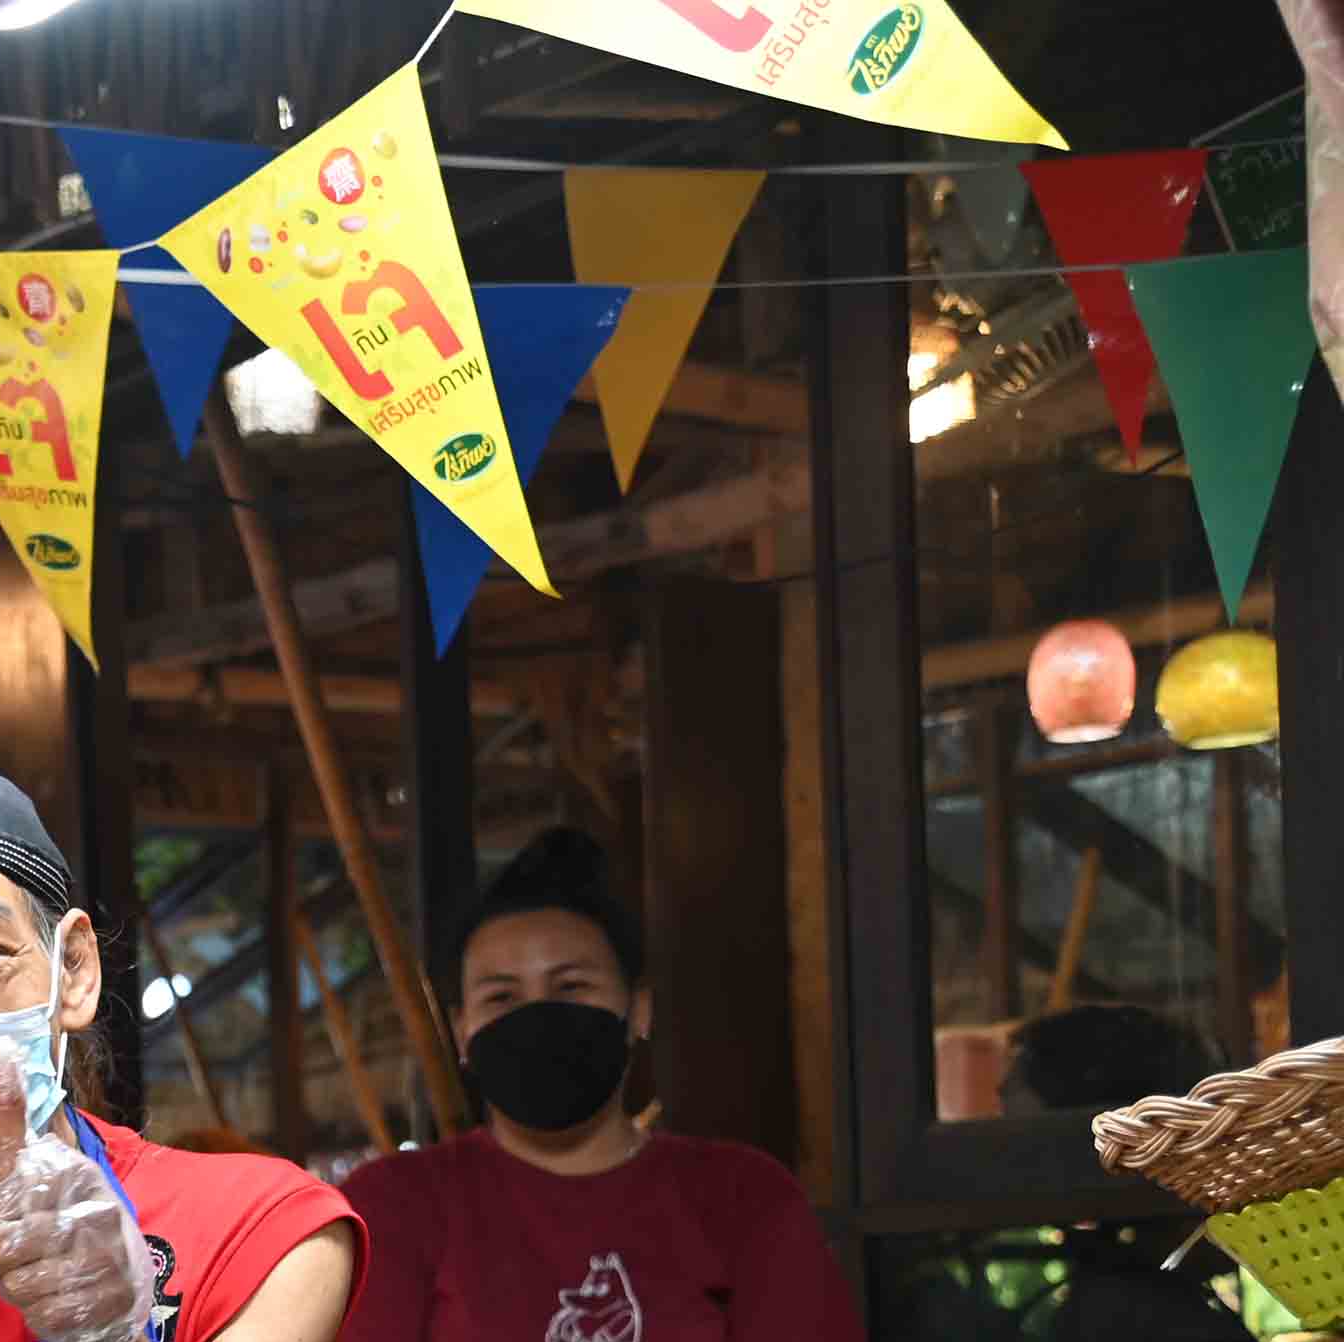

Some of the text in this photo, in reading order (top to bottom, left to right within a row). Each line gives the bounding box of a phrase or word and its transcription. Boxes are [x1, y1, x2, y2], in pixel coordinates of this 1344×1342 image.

[352, 324, 389, 355] กิน
[368, 356, 483, 435] เสริมสุขภาพ
